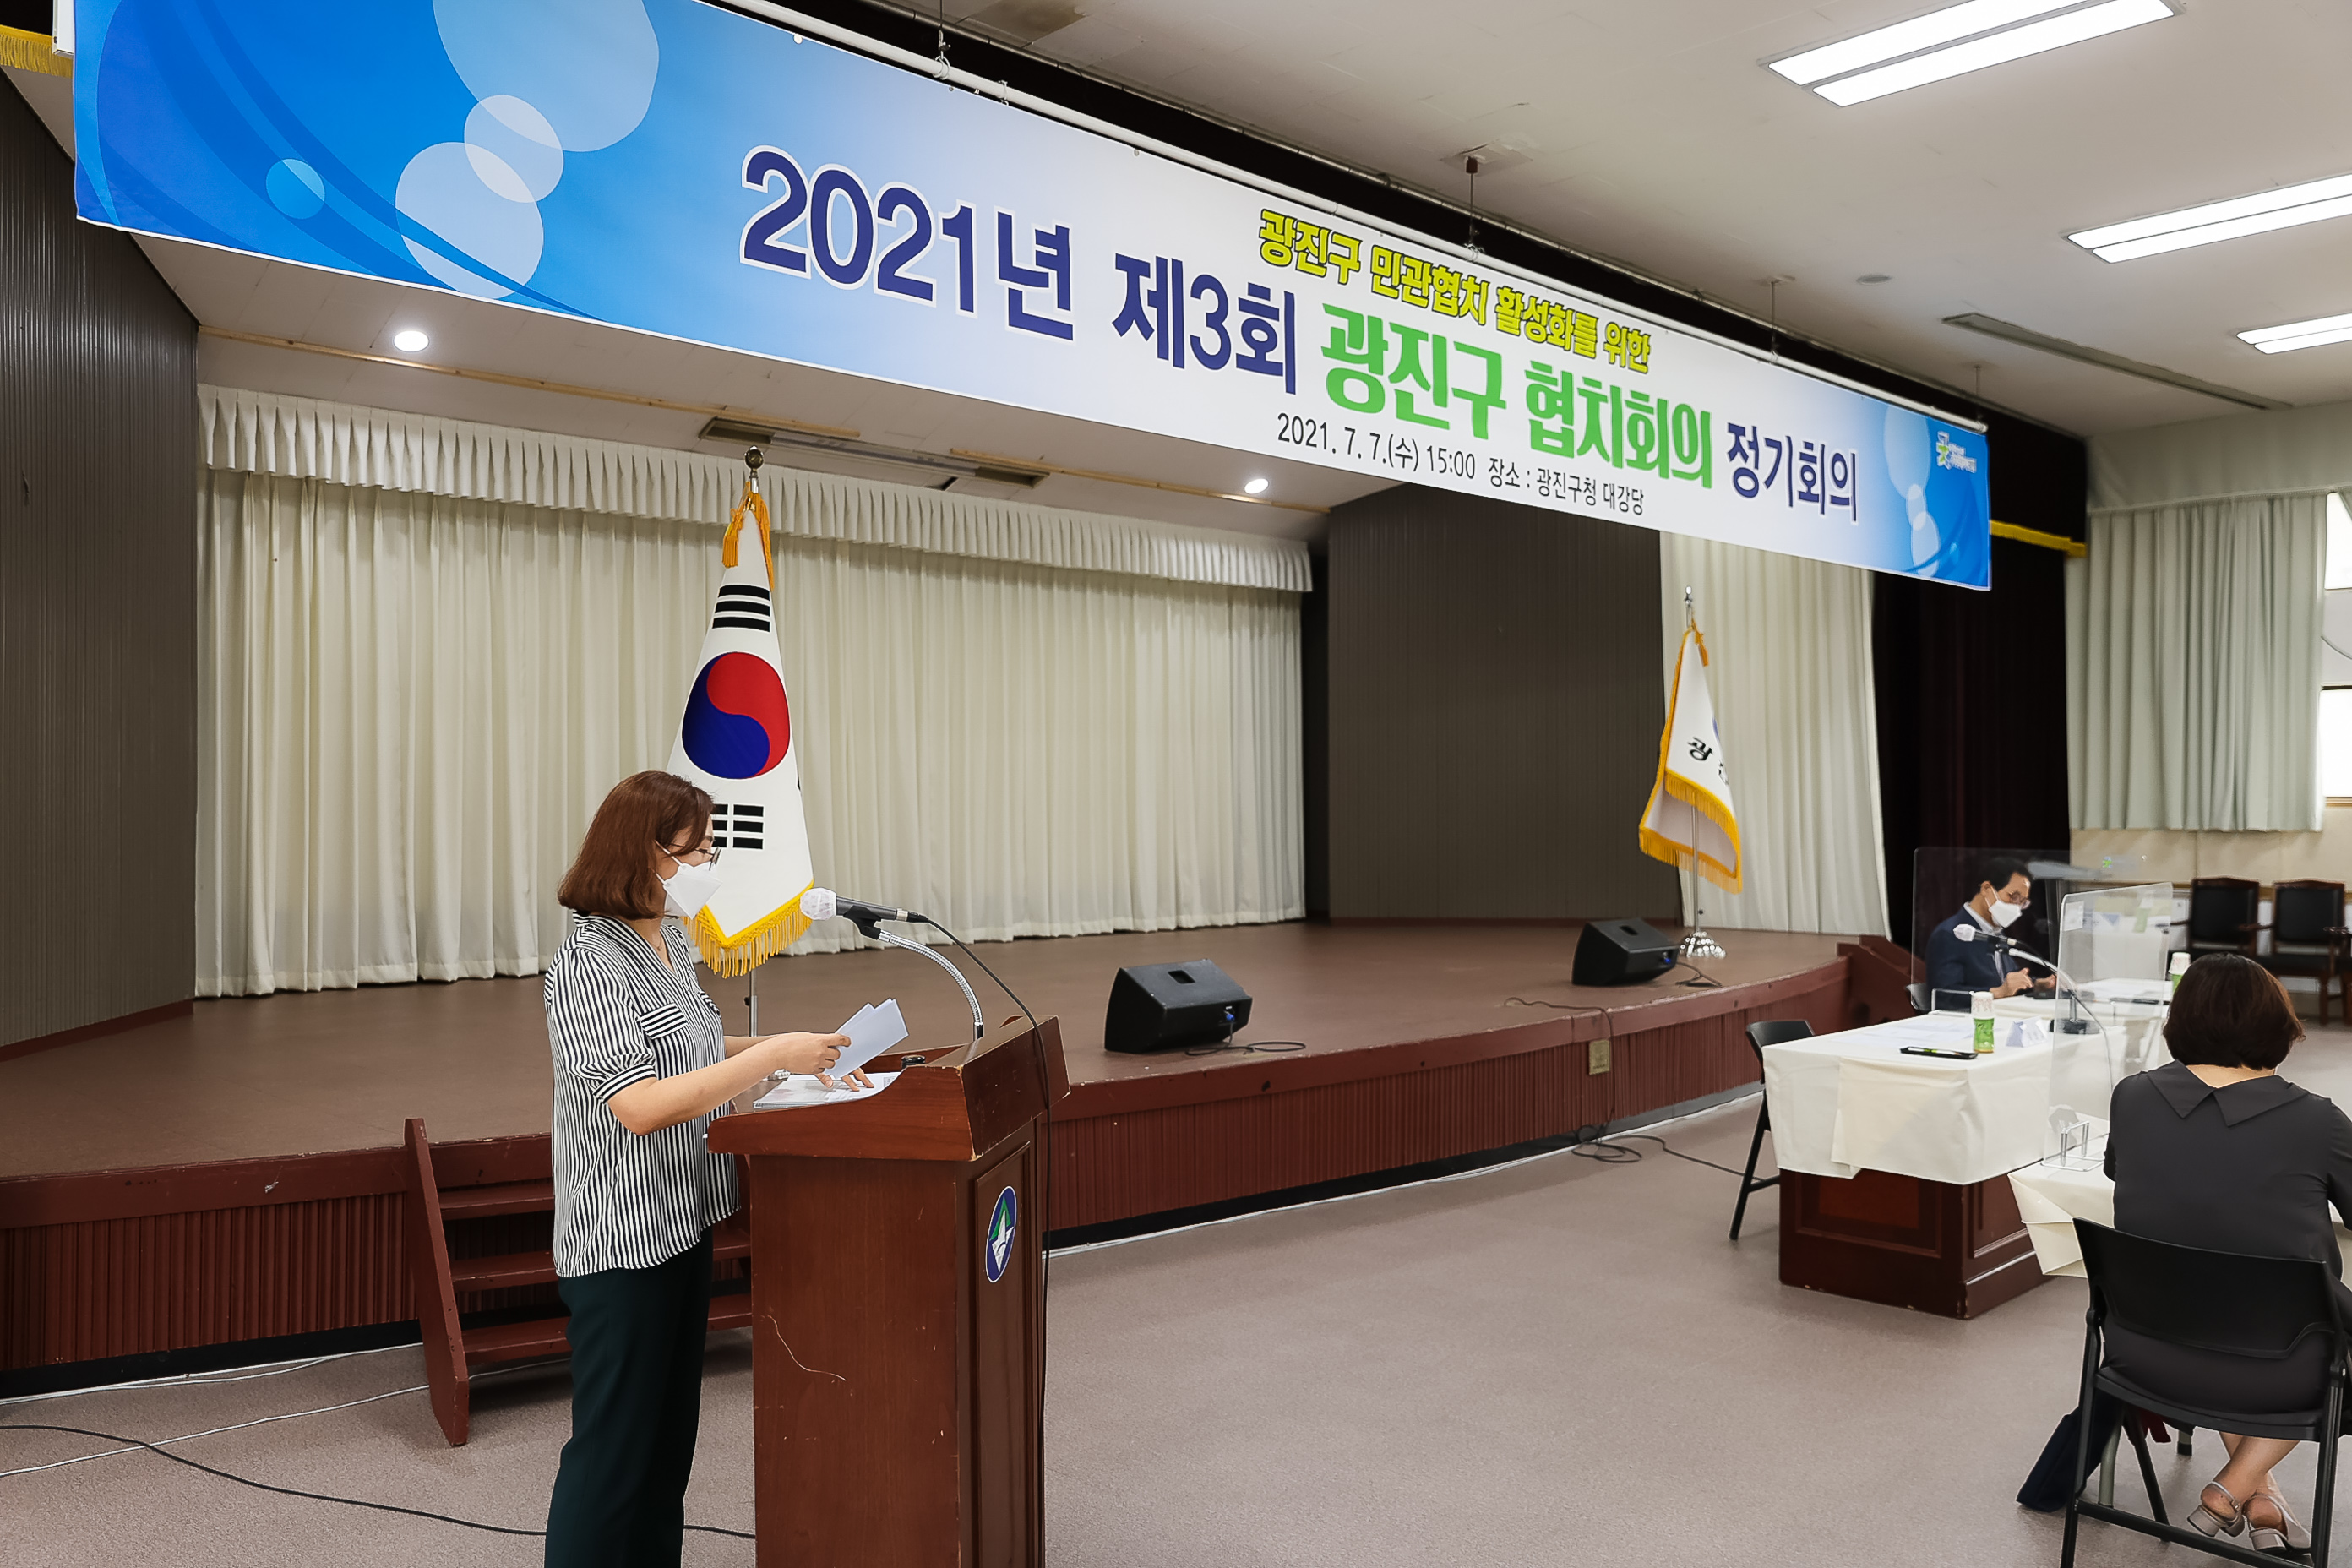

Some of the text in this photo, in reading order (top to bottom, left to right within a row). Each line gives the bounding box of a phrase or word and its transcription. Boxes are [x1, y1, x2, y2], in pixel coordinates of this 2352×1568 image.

[743, 145, 1857, 522] 2021년 제3회 광진구 협치회의 정기회의
[1259, 208, 1652, 374] 광진구 민관협치 활성화를 위한
[1426, 444, 1476, 480] 15:00
[1488, 457, 1521, 488] 장소
[1537, 467, 1597, 507] 광진구청
[1603, 482, 1645, 515] 대강당
